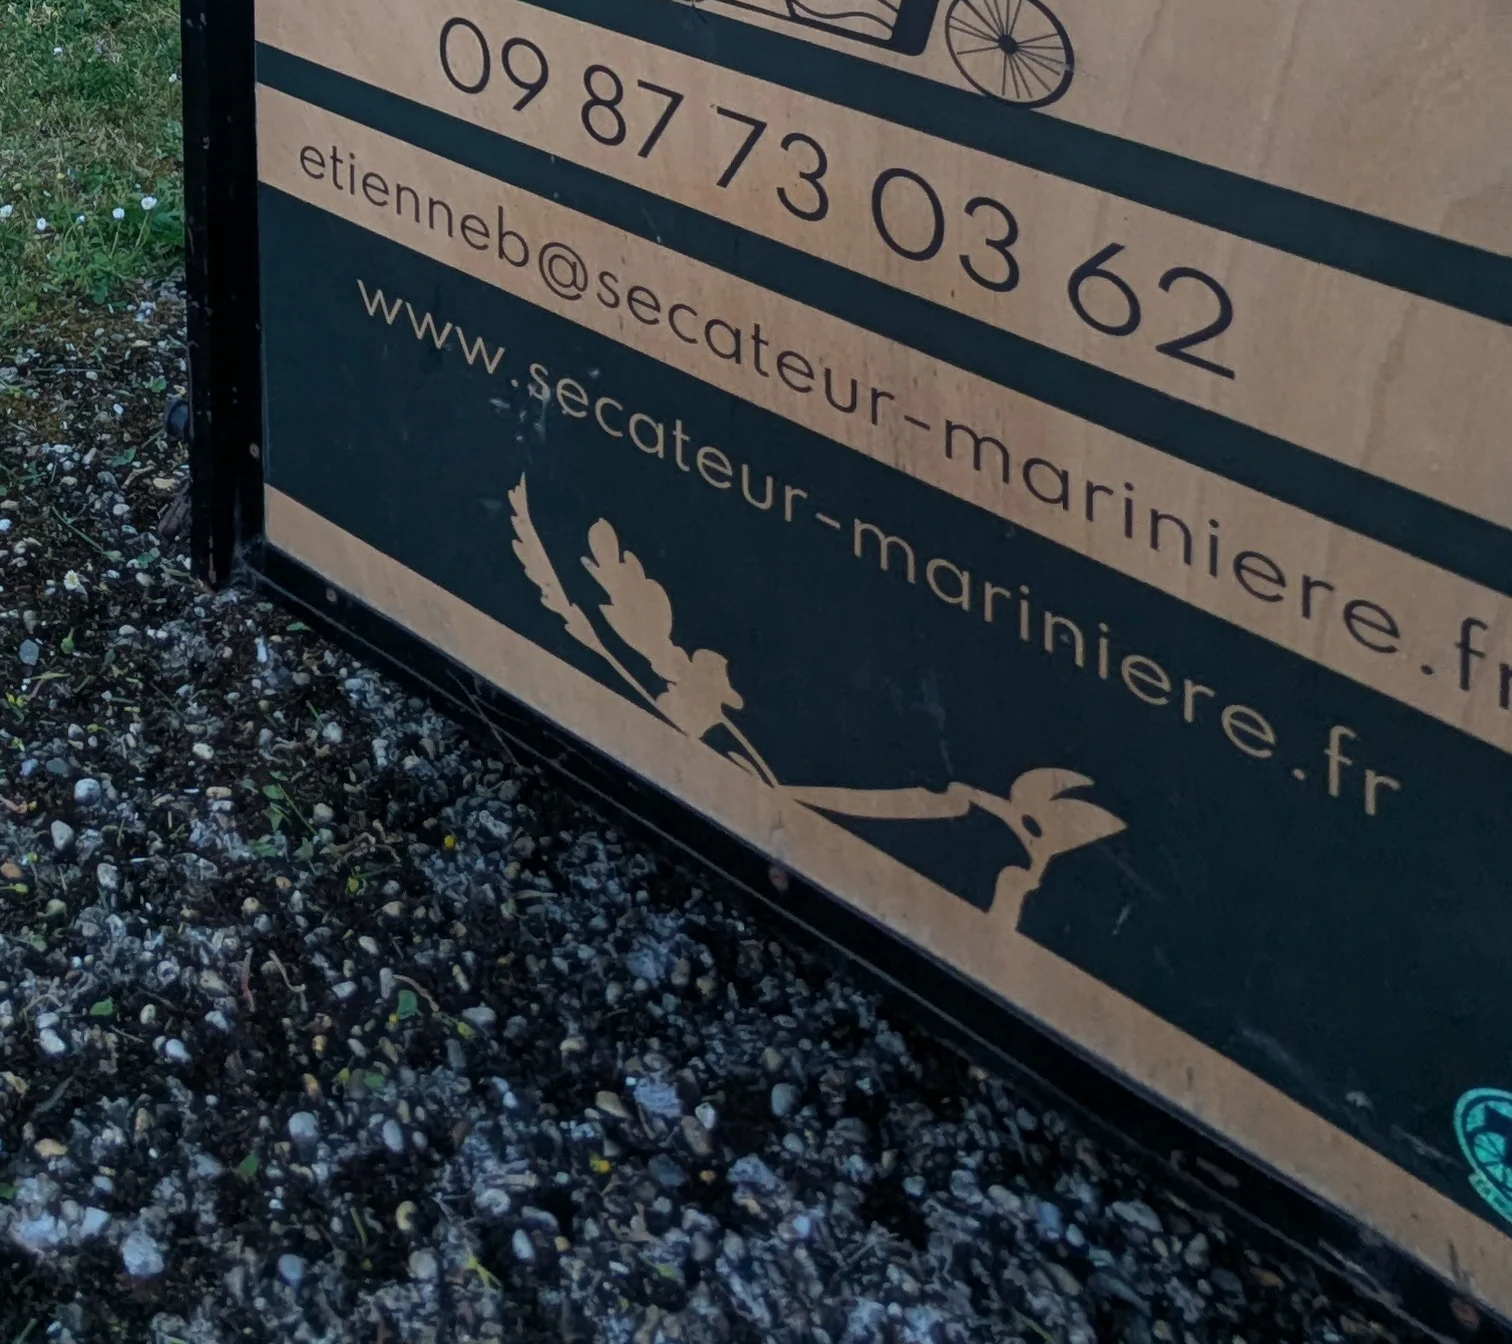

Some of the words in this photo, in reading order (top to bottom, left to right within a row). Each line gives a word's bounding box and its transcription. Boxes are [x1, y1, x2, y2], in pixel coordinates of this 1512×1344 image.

[439, 17, 550, 113] 09
[581, 64, 685, 160] 87
[716, 105, 829, 223] 73
[871, 167, 1021, 294] 03
[1066, 242, 1238, 382] 62
